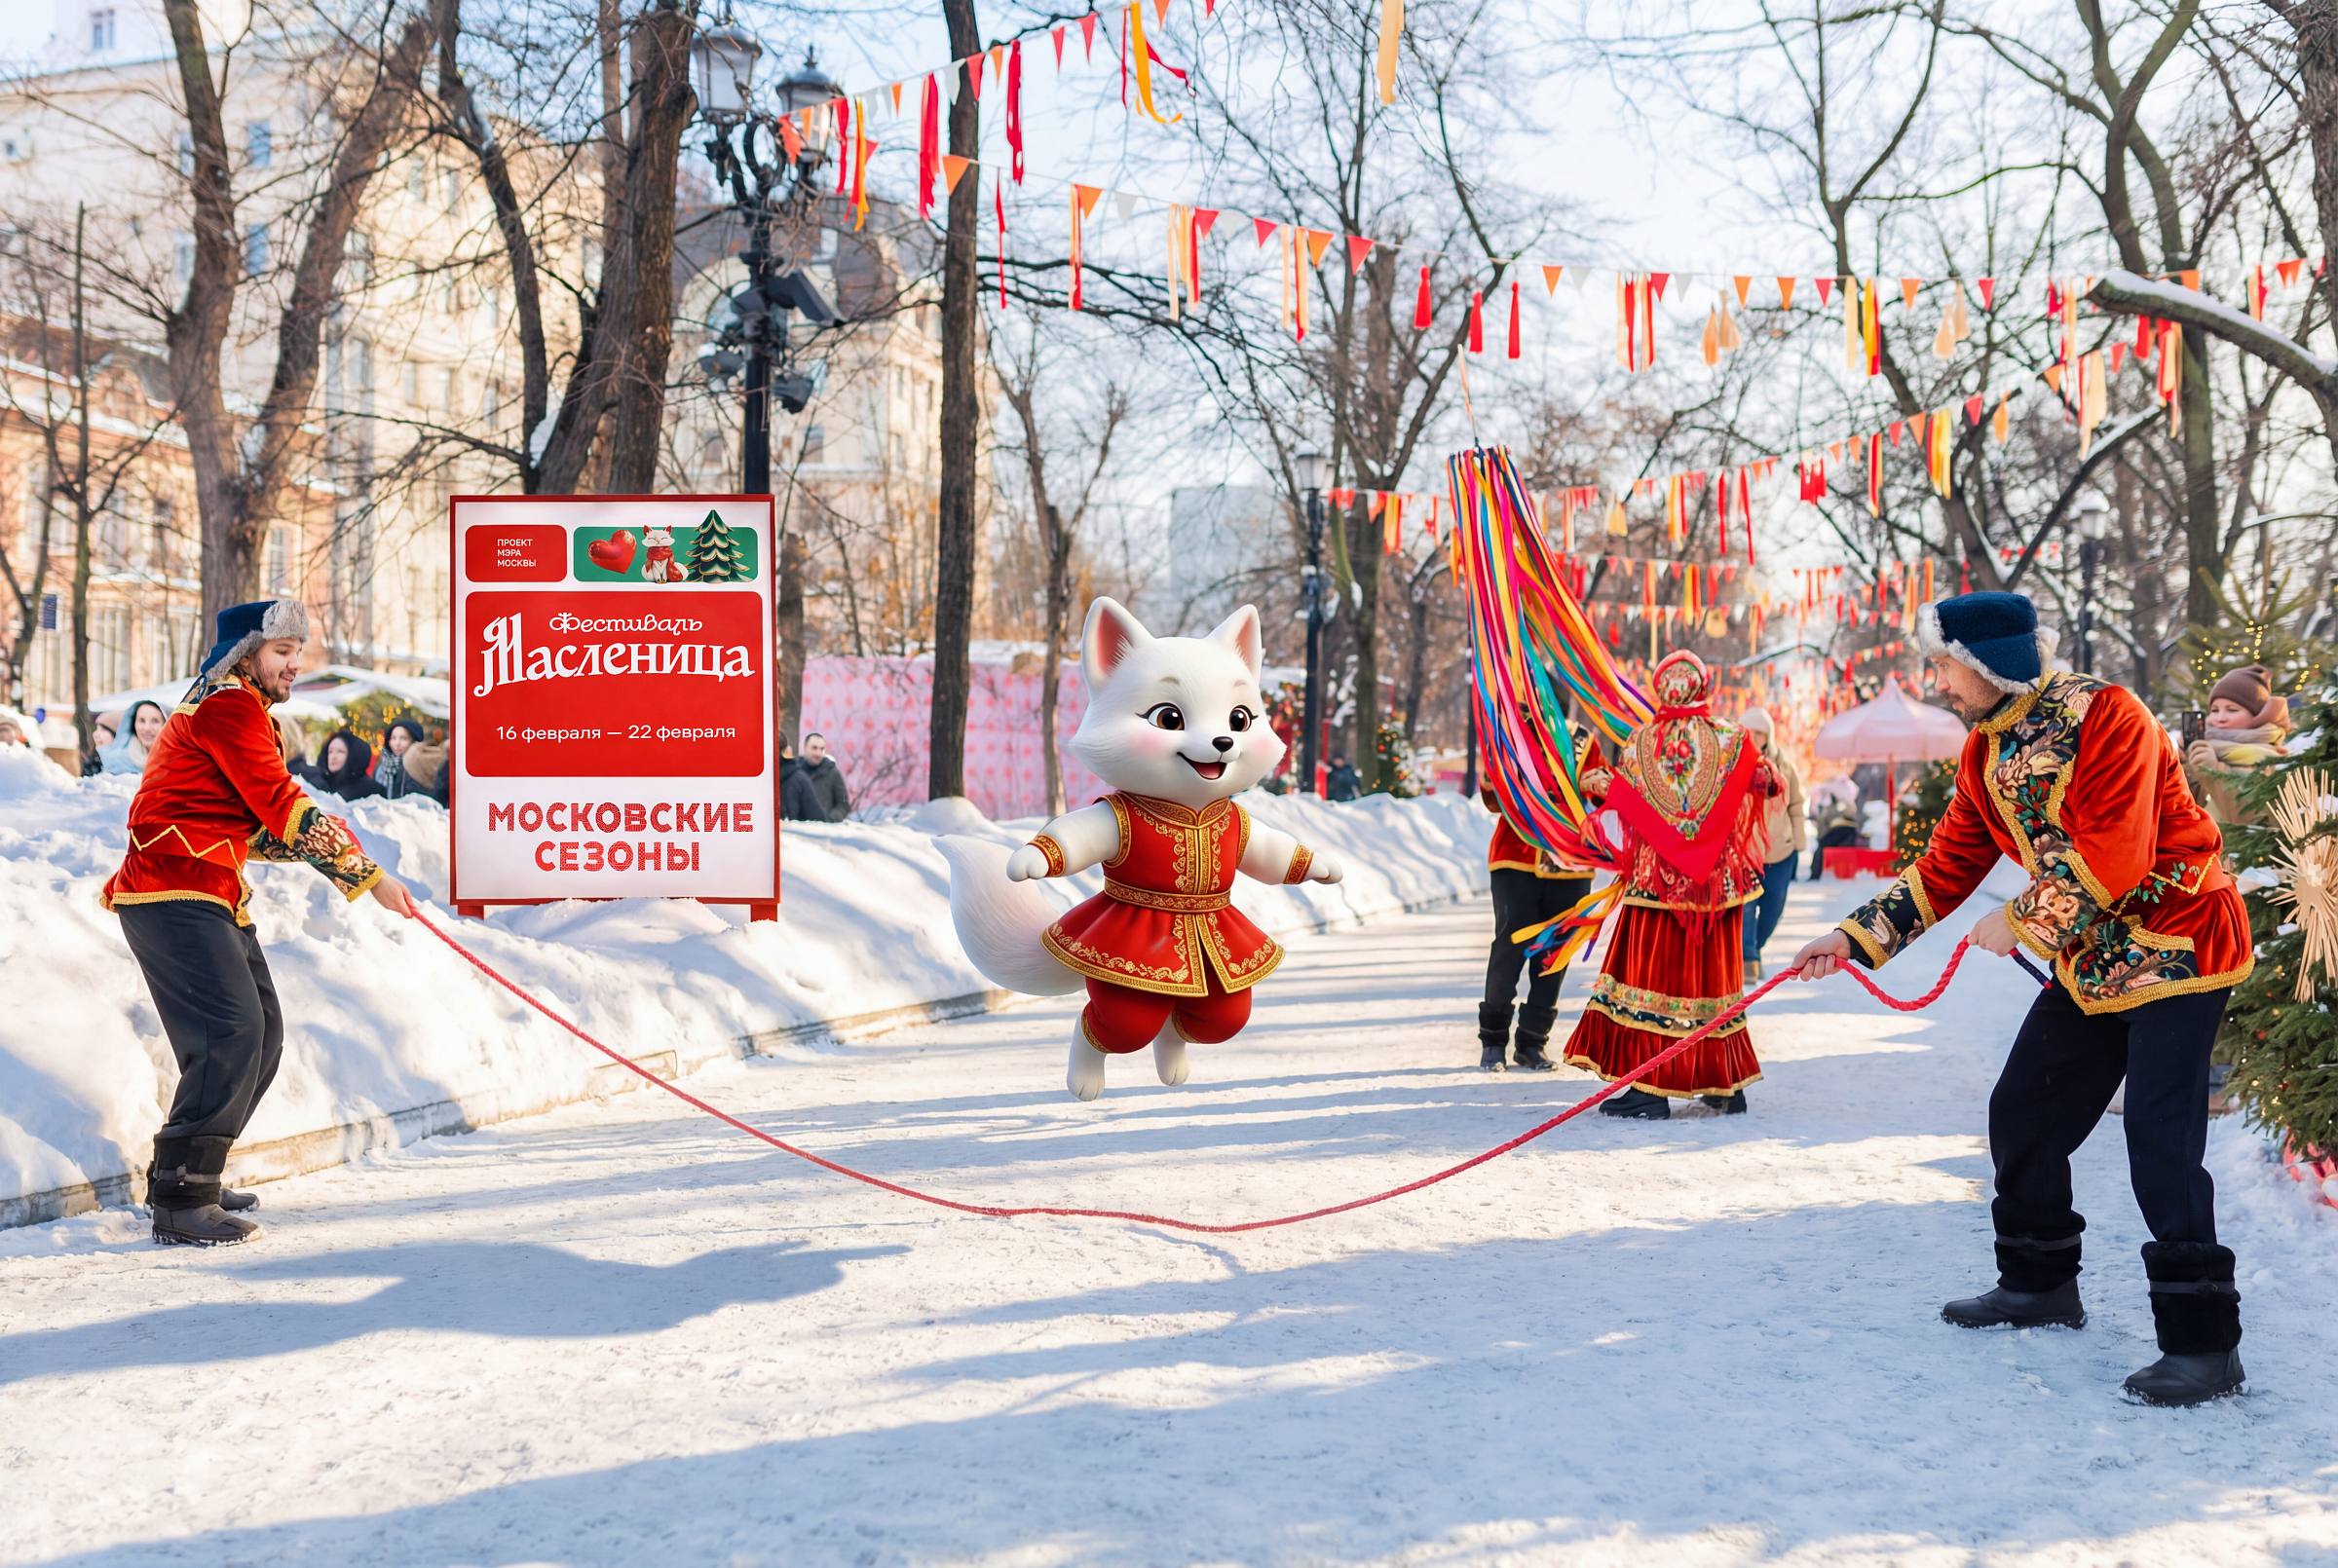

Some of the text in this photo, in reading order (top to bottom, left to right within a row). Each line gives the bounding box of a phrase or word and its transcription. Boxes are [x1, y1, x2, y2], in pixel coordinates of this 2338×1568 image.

[497, 548, 522, 557] МЭРА
[548, 612, 703, 636] Фестиваль
[472, 612, 756, 697] Масленица
[496, 725, 517, 740] 16
[521, 726, 601, 744] февраля
[627, 725, 652, 740] 22
[656, 725, 735, 742] февраля
[488, 802, 754, 834] МОСКОВСКИЕ
[534, 840, 700, 873] СЕЗОНЫ
